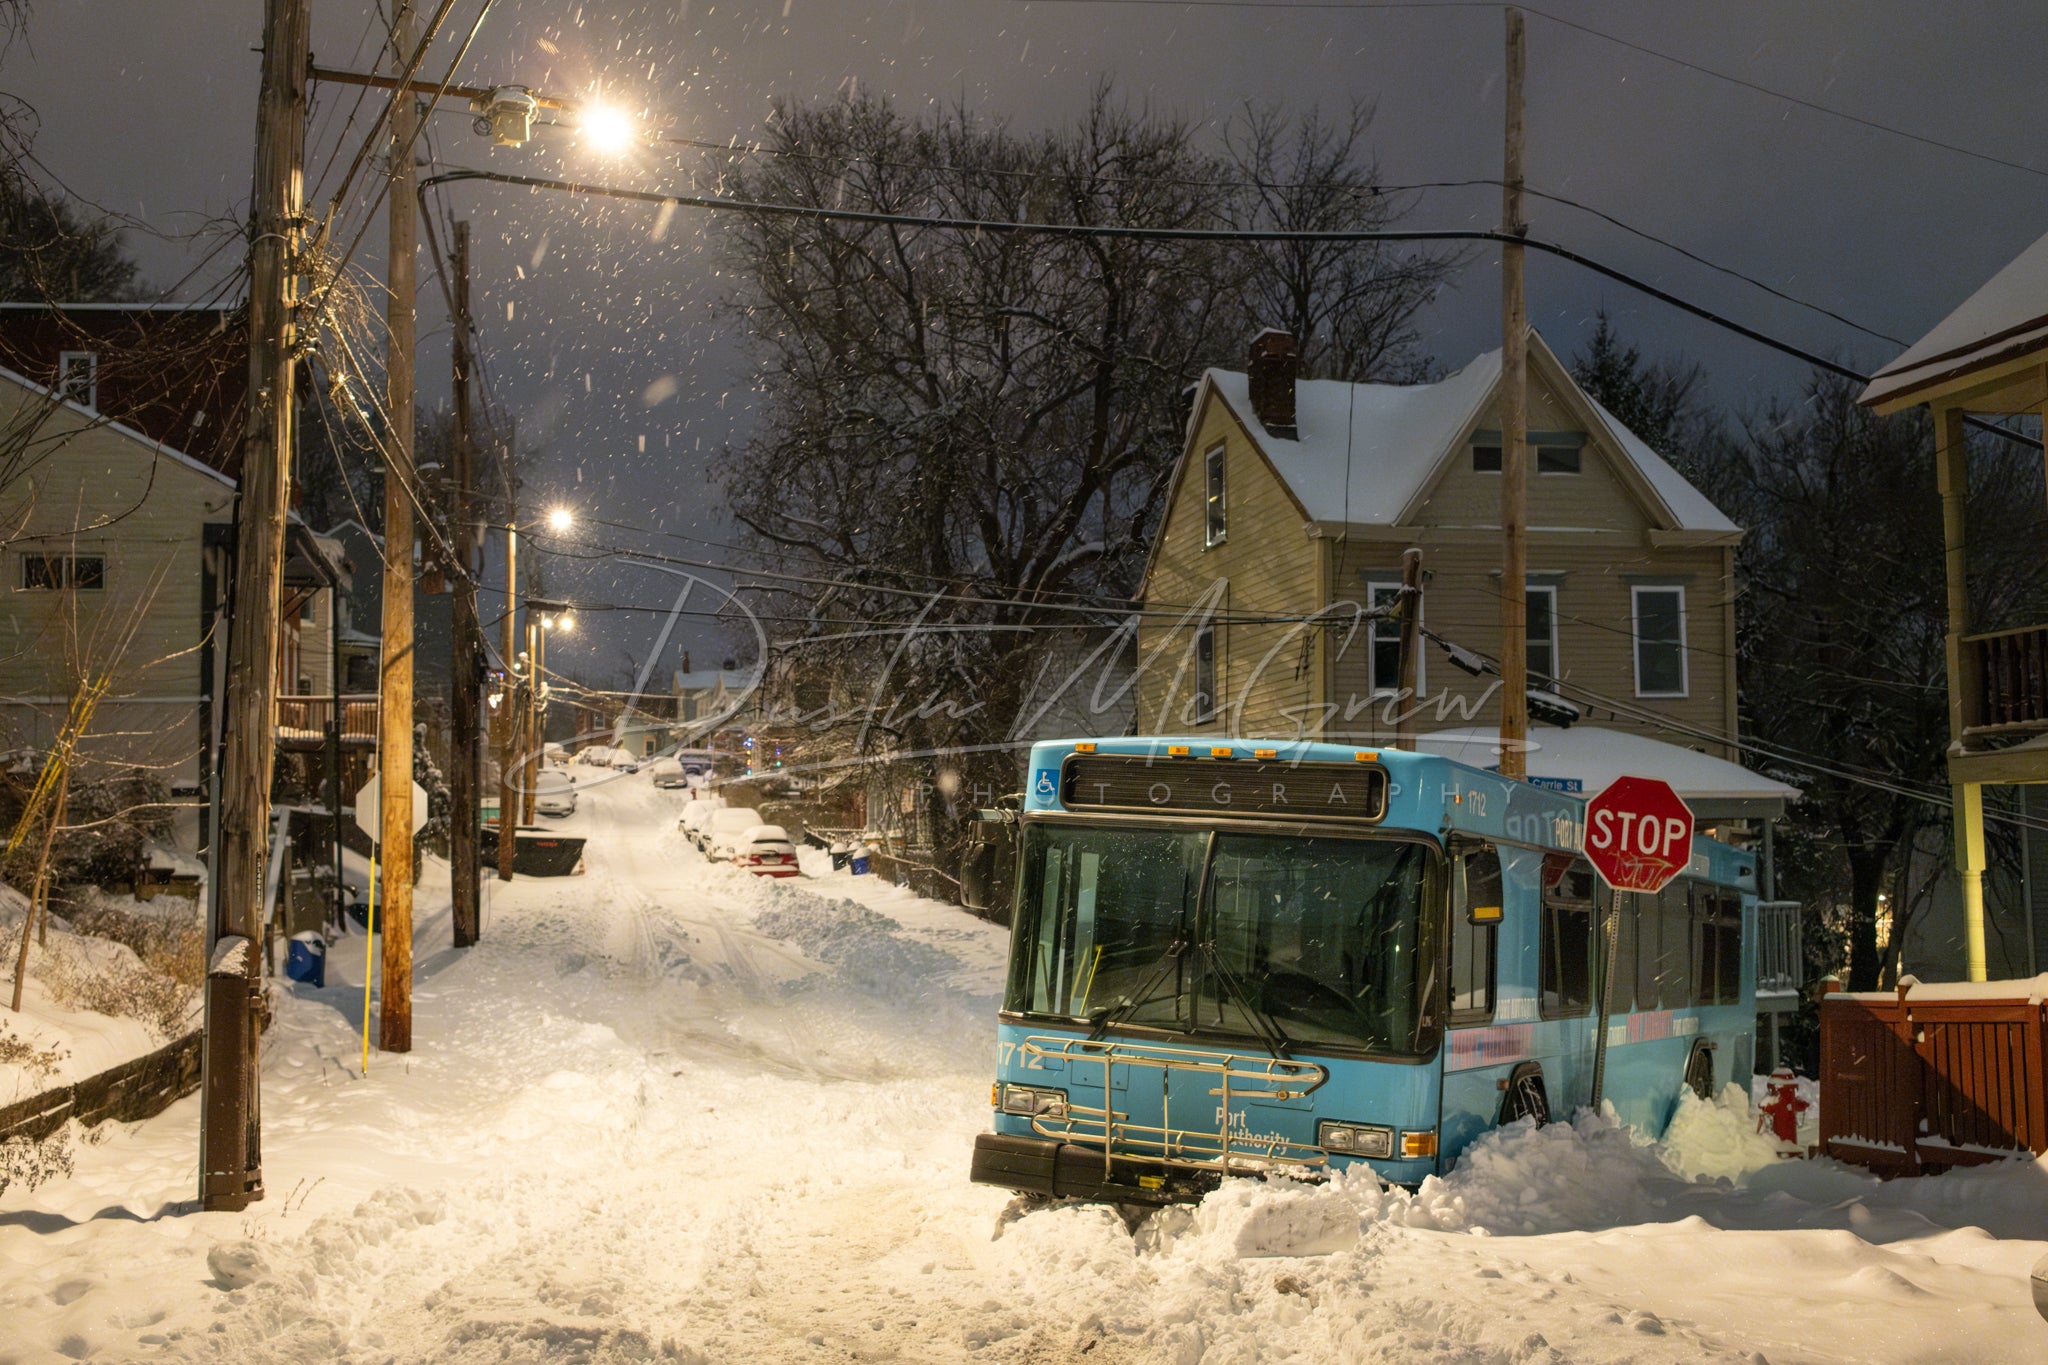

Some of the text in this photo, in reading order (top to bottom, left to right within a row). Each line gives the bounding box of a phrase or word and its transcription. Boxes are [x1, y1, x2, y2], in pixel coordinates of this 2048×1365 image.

[1532, 779, 1578, 791] Carrie St
[1468, 791, 1487, 817] 1712
[1555, 817, 1573, 849] PORT
[1591, 809, 1686, 857] STOP
[998, 1041, 1043, 1070] 1712
[1215, 1106, 1247, 1128] Port
